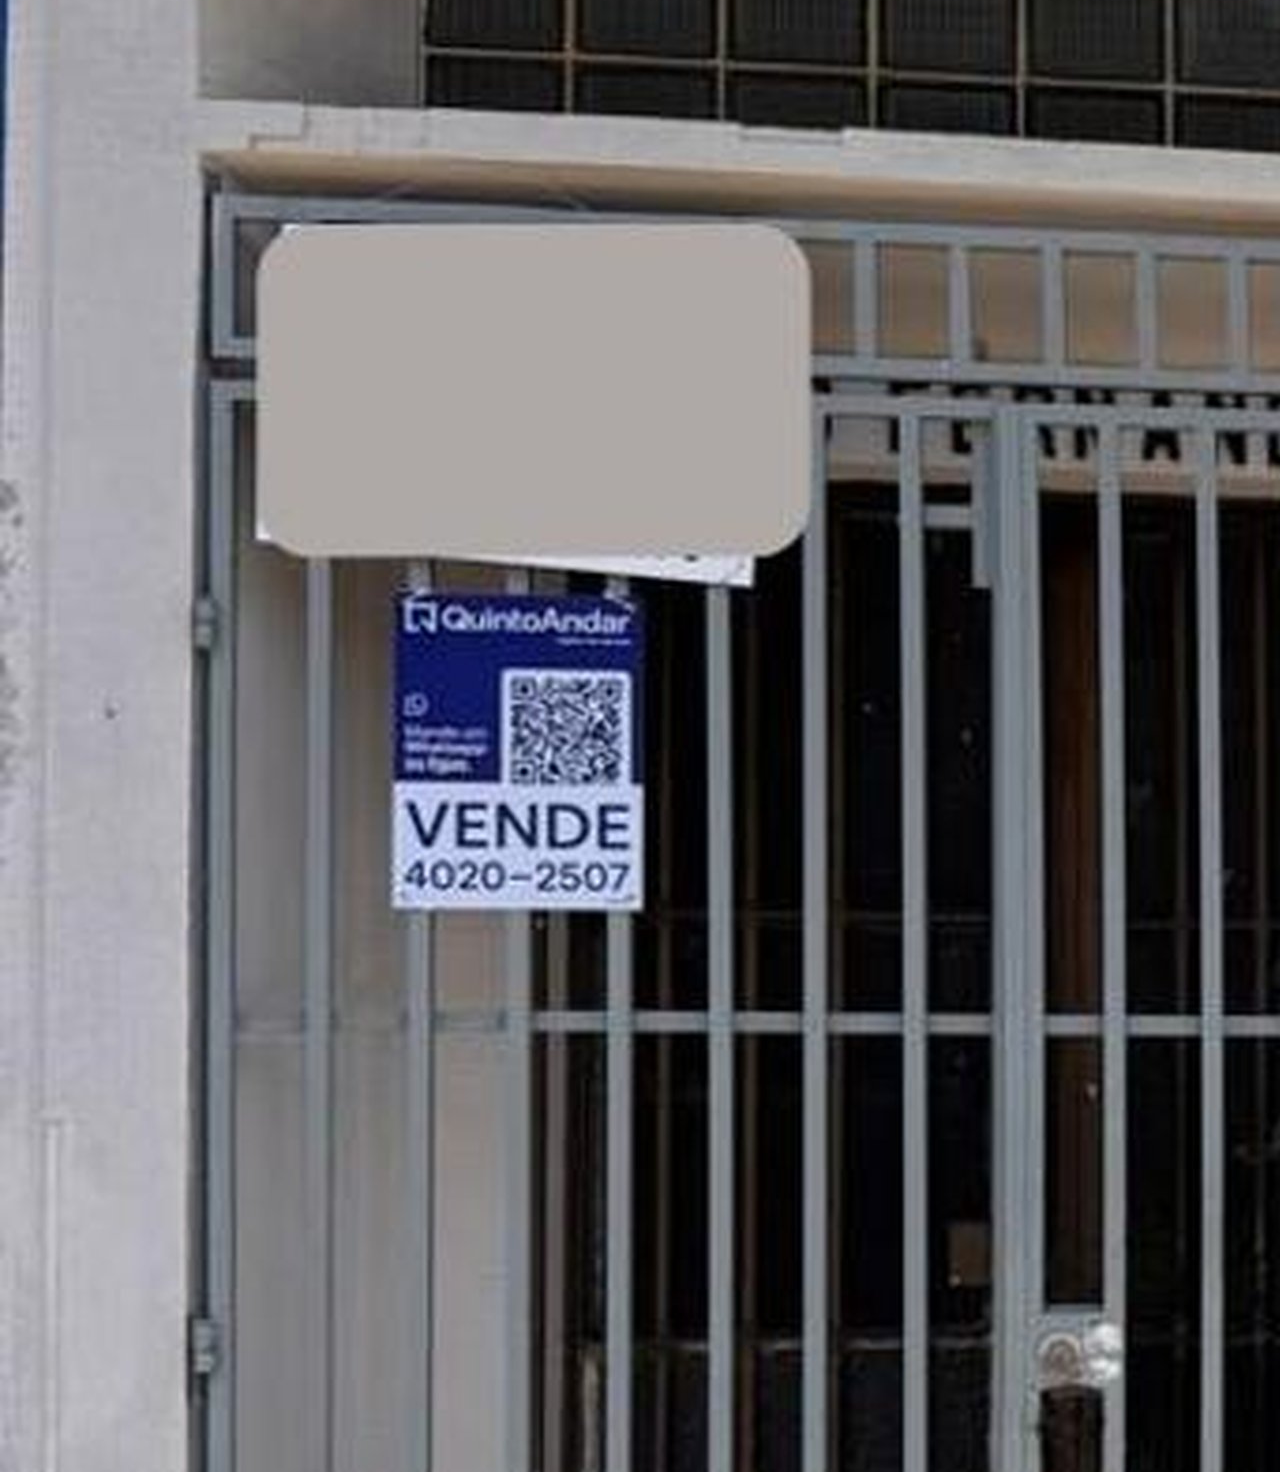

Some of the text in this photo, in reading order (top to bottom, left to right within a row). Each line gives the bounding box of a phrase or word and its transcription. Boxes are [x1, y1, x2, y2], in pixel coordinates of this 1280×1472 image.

[441, 605, 631, 635] QuintoAndar
[405, 800, 631, 850] VENDE
[404, 859, 631, 892] 4020-2507
